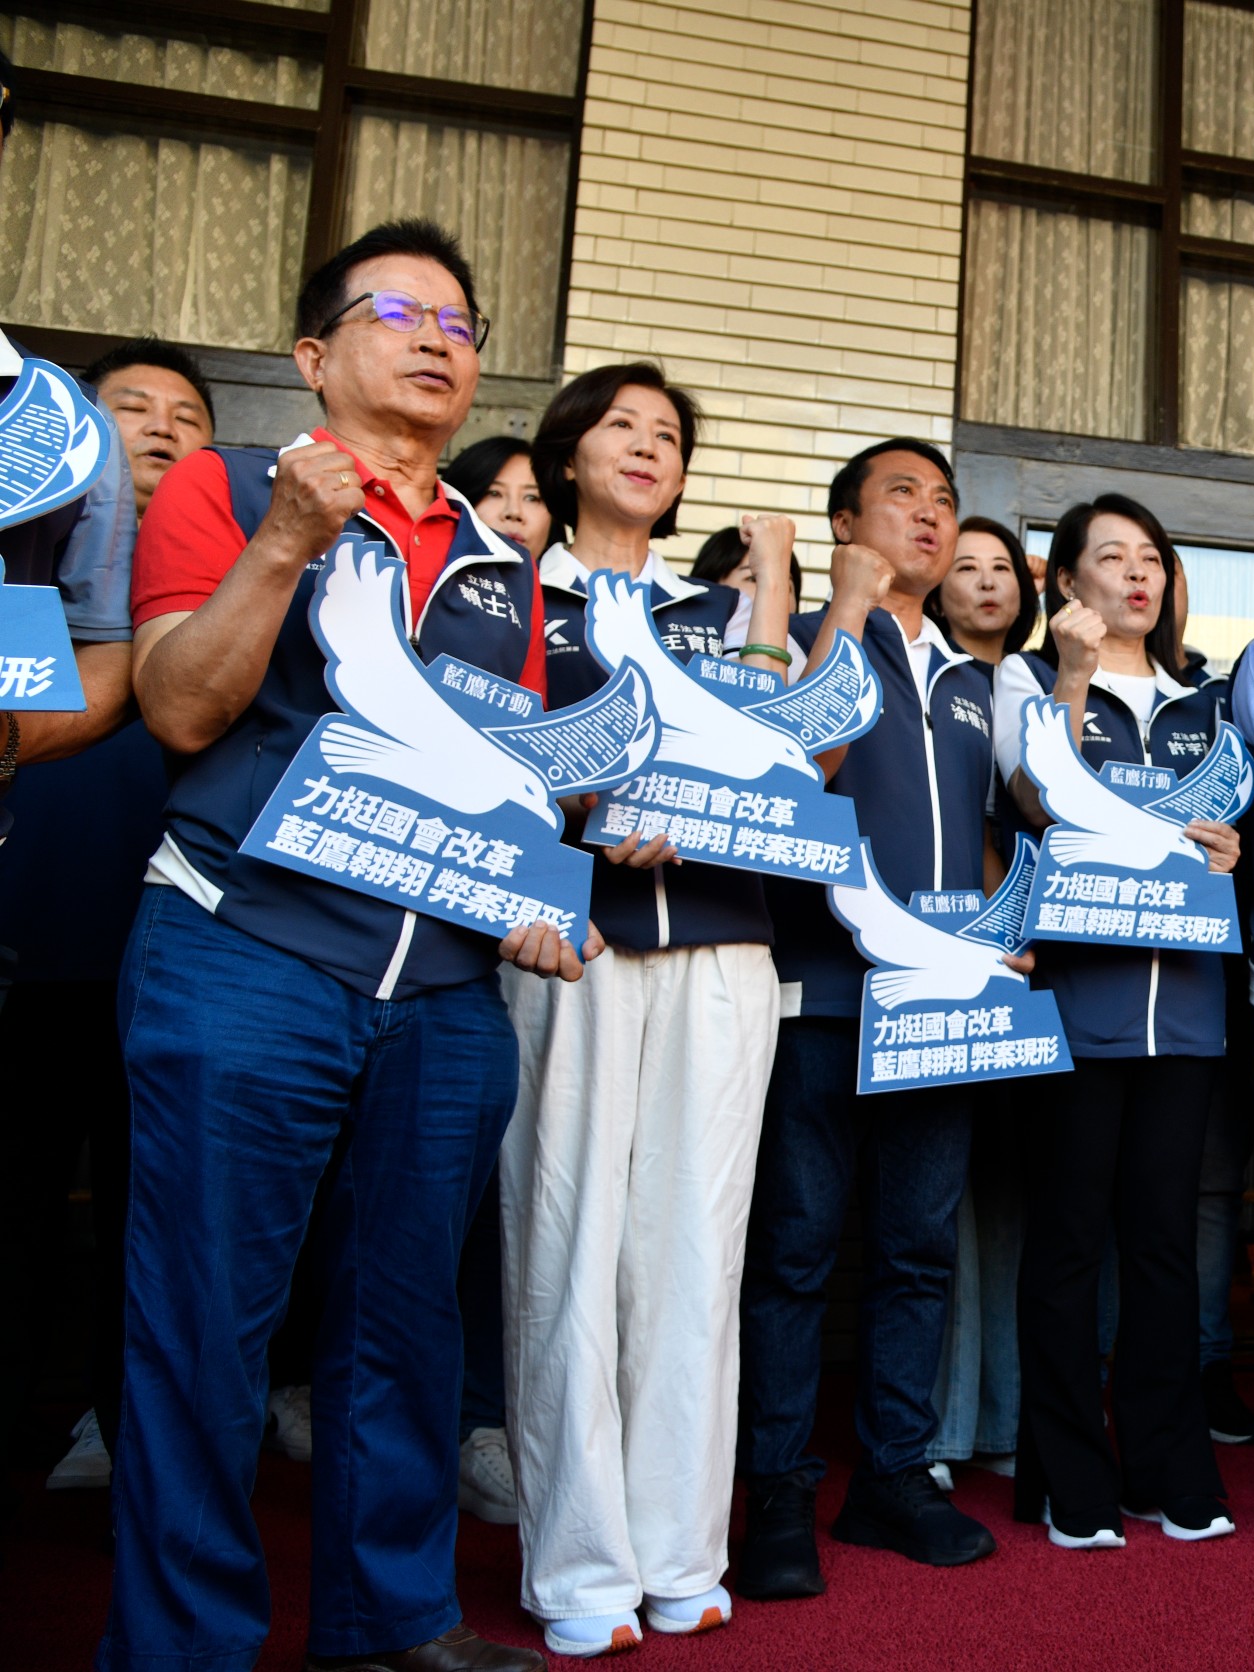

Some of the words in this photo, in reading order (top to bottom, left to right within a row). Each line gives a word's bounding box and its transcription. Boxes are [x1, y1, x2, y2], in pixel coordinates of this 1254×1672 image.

[466, 574, 511, 598] 立法委
[661, 634, 724, 658] 王育敏
[0, 656, 56, 698] 形
[441, 663, 533, 718] 藍鷹行動
[700, 659, 775, 694] 藍鷹行動
[1110, 766, 1171, 790] 藍鷹行動
[292, 775, 523, 878] 力挺國會改革
[601, 802, 732, 855] 藍鷹翱翔
[733, 826, 851, 875] 弊案現形
[266, 813, 434, 897] 藍鷹翱翔
[428, 867, 577, 940] 弊案現形
[1043, 870, 1188, 909] 力挺國會改革
[919, 893, 980, 913] 藍鷹行動
[1035, 902, 1136, 937] 藍鷹翱翔
[1137, 911, 1231, 944] 弊案現形
[873, 1006, 1013, 1047] 力挺國會改革
[870, 1043, 967, 1083] 藍鷹翱翔
[971, 1035, 1059, 1071] 弊案現形
